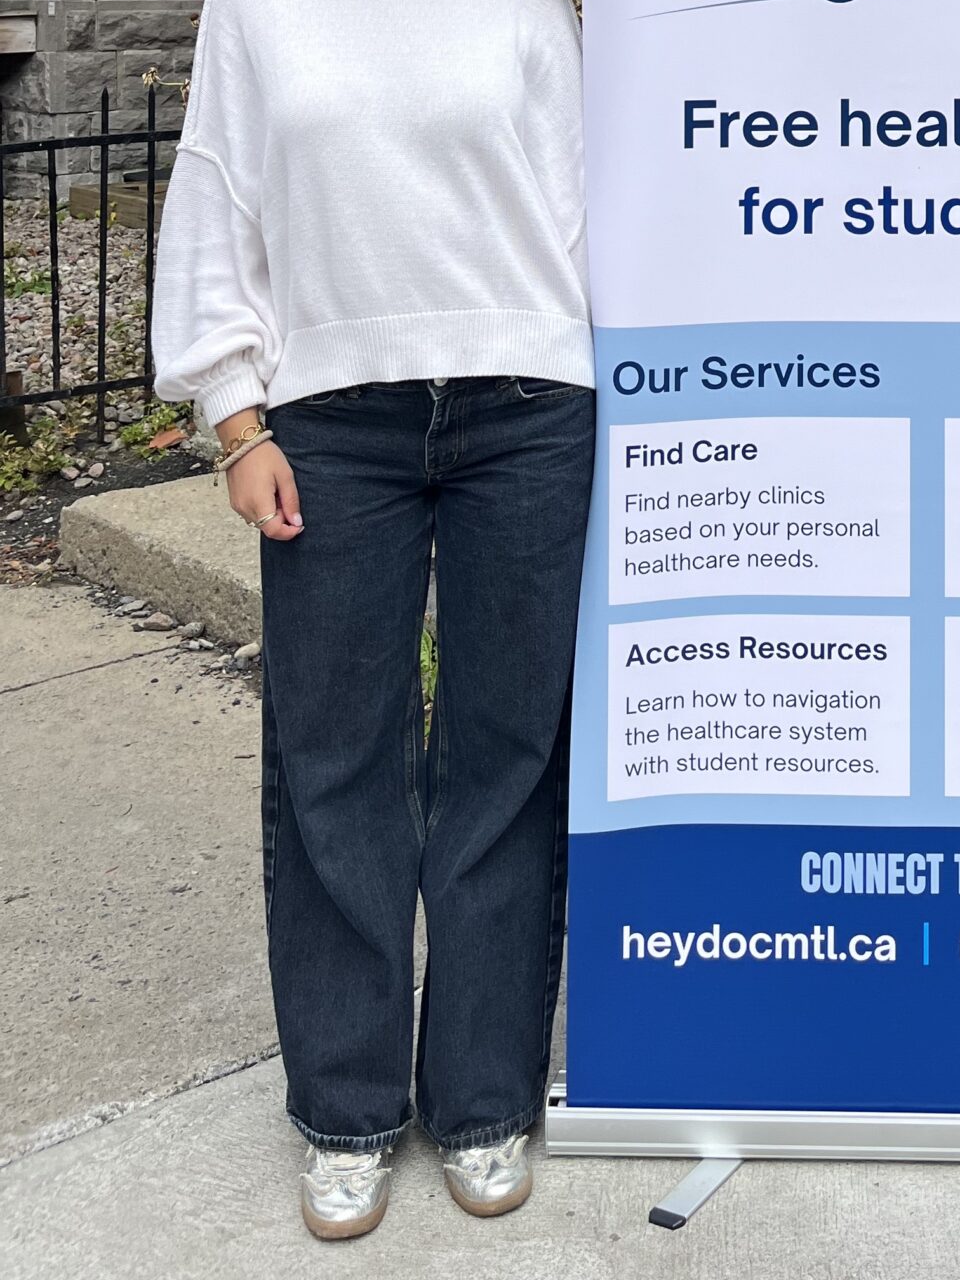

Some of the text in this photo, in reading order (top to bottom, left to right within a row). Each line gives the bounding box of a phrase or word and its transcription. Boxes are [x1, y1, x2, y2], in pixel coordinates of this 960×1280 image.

[684, 100, 818, 149] Free
[739, 187, 823, 235] for
[613, 354, 880, 395] Our Services
[626, 440, 757, 468] Find Care
[626, 486, 824, 512] Find nearby clinics
[626, 519, 879, 544] based on your personal
[625, 549, 818, 576] healthcare needs.
[626, 637, 887, 667] Access Resources
[627, 689, 880, 714] Learn how to navigation
[625, 721, 866, 745] the healthcare system
[625, 753, 878, 776] with student resources.
[801, 852, 944, 894] CONNECT
[623, 924, 896, 966] heydocmtl.ca
